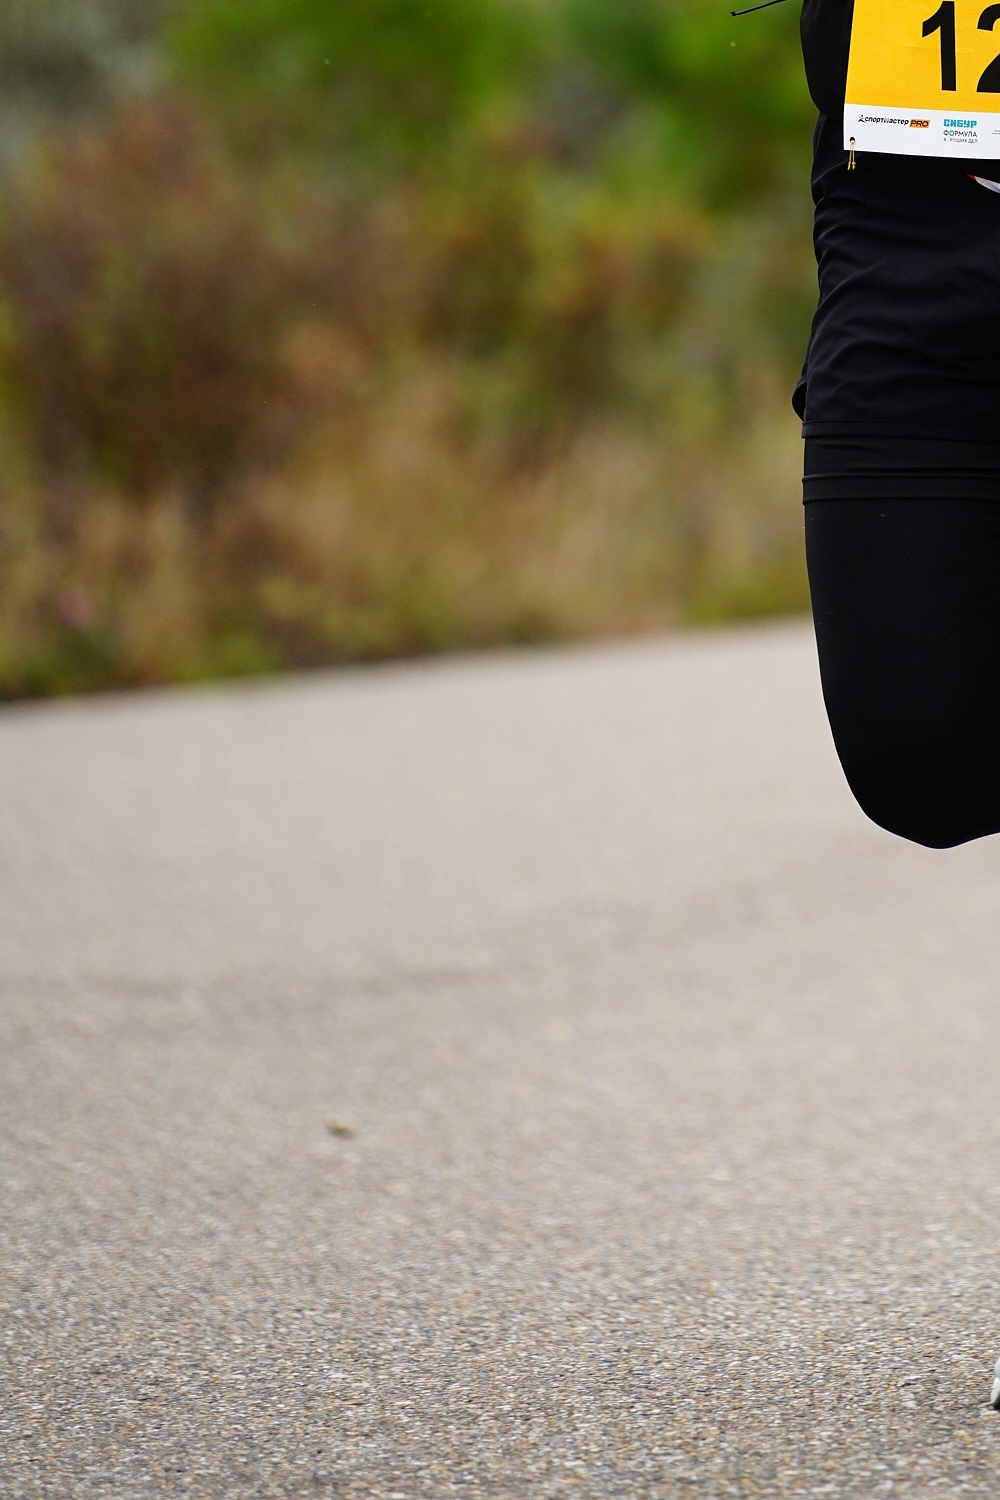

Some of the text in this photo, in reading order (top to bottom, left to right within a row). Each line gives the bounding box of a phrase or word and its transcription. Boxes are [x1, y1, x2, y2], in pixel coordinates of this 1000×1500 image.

[910, 119, 929, 128] PRO
[943, 118, 978, 128] СИБУР
[943, 129, 978, 138] ФОРМУЛА
